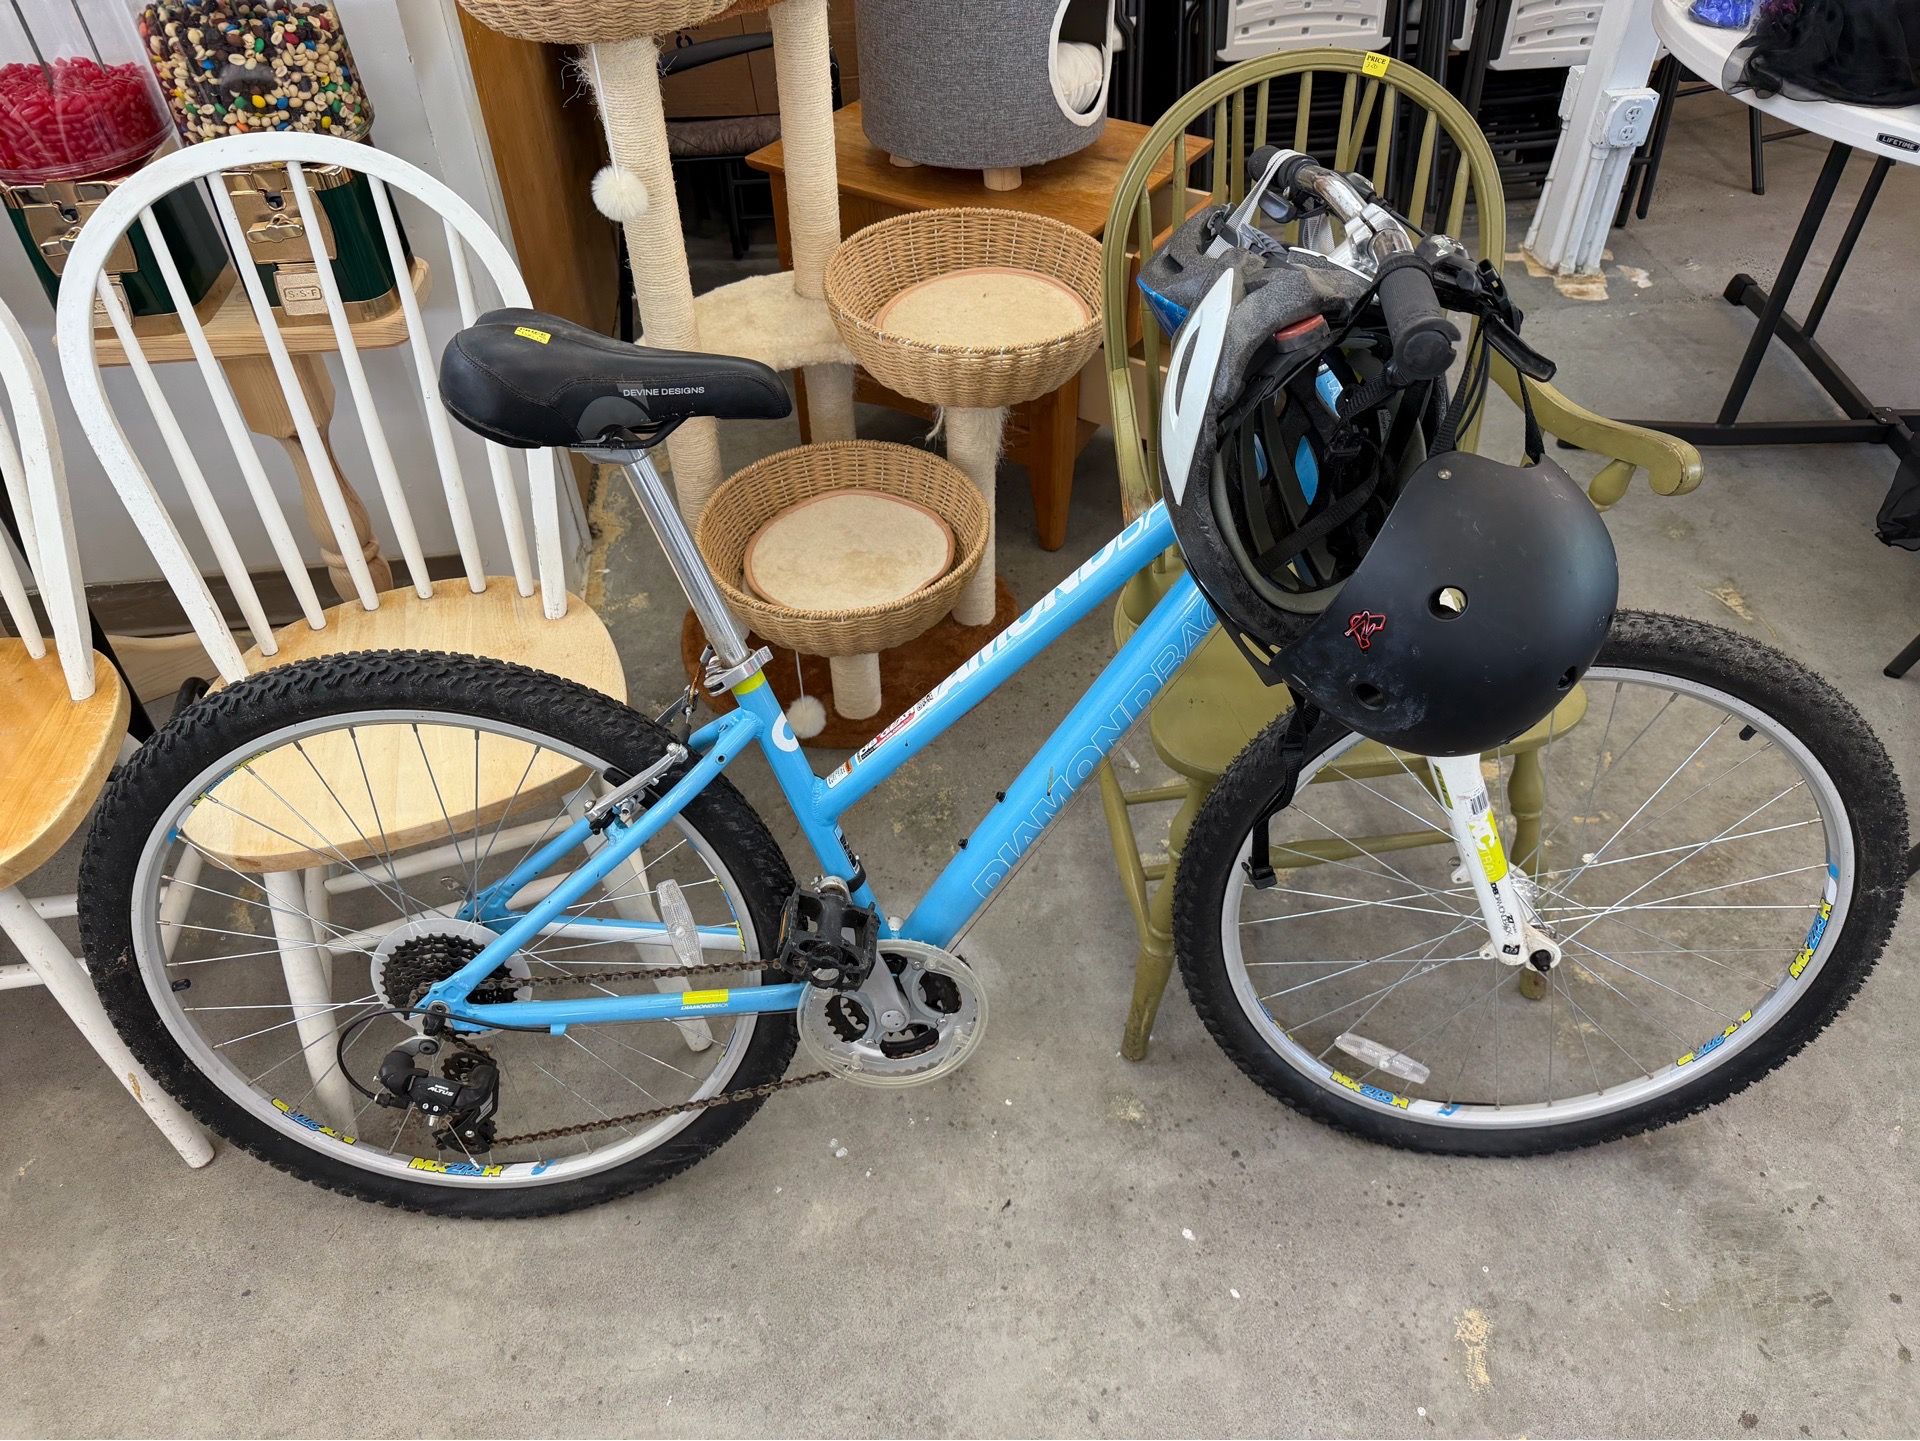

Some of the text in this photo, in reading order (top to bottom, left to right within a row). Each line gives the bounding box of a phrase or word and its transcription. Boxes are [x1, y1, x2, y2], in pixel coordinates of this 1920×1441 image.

[1366, 55, 1387, 65] PRICE
[1882, 135, 1916, 150] LIFETIME
[623, 386, 705, 397] DEVINE DESIGNS
[427, 1086, 455, 1097] ALTUS
